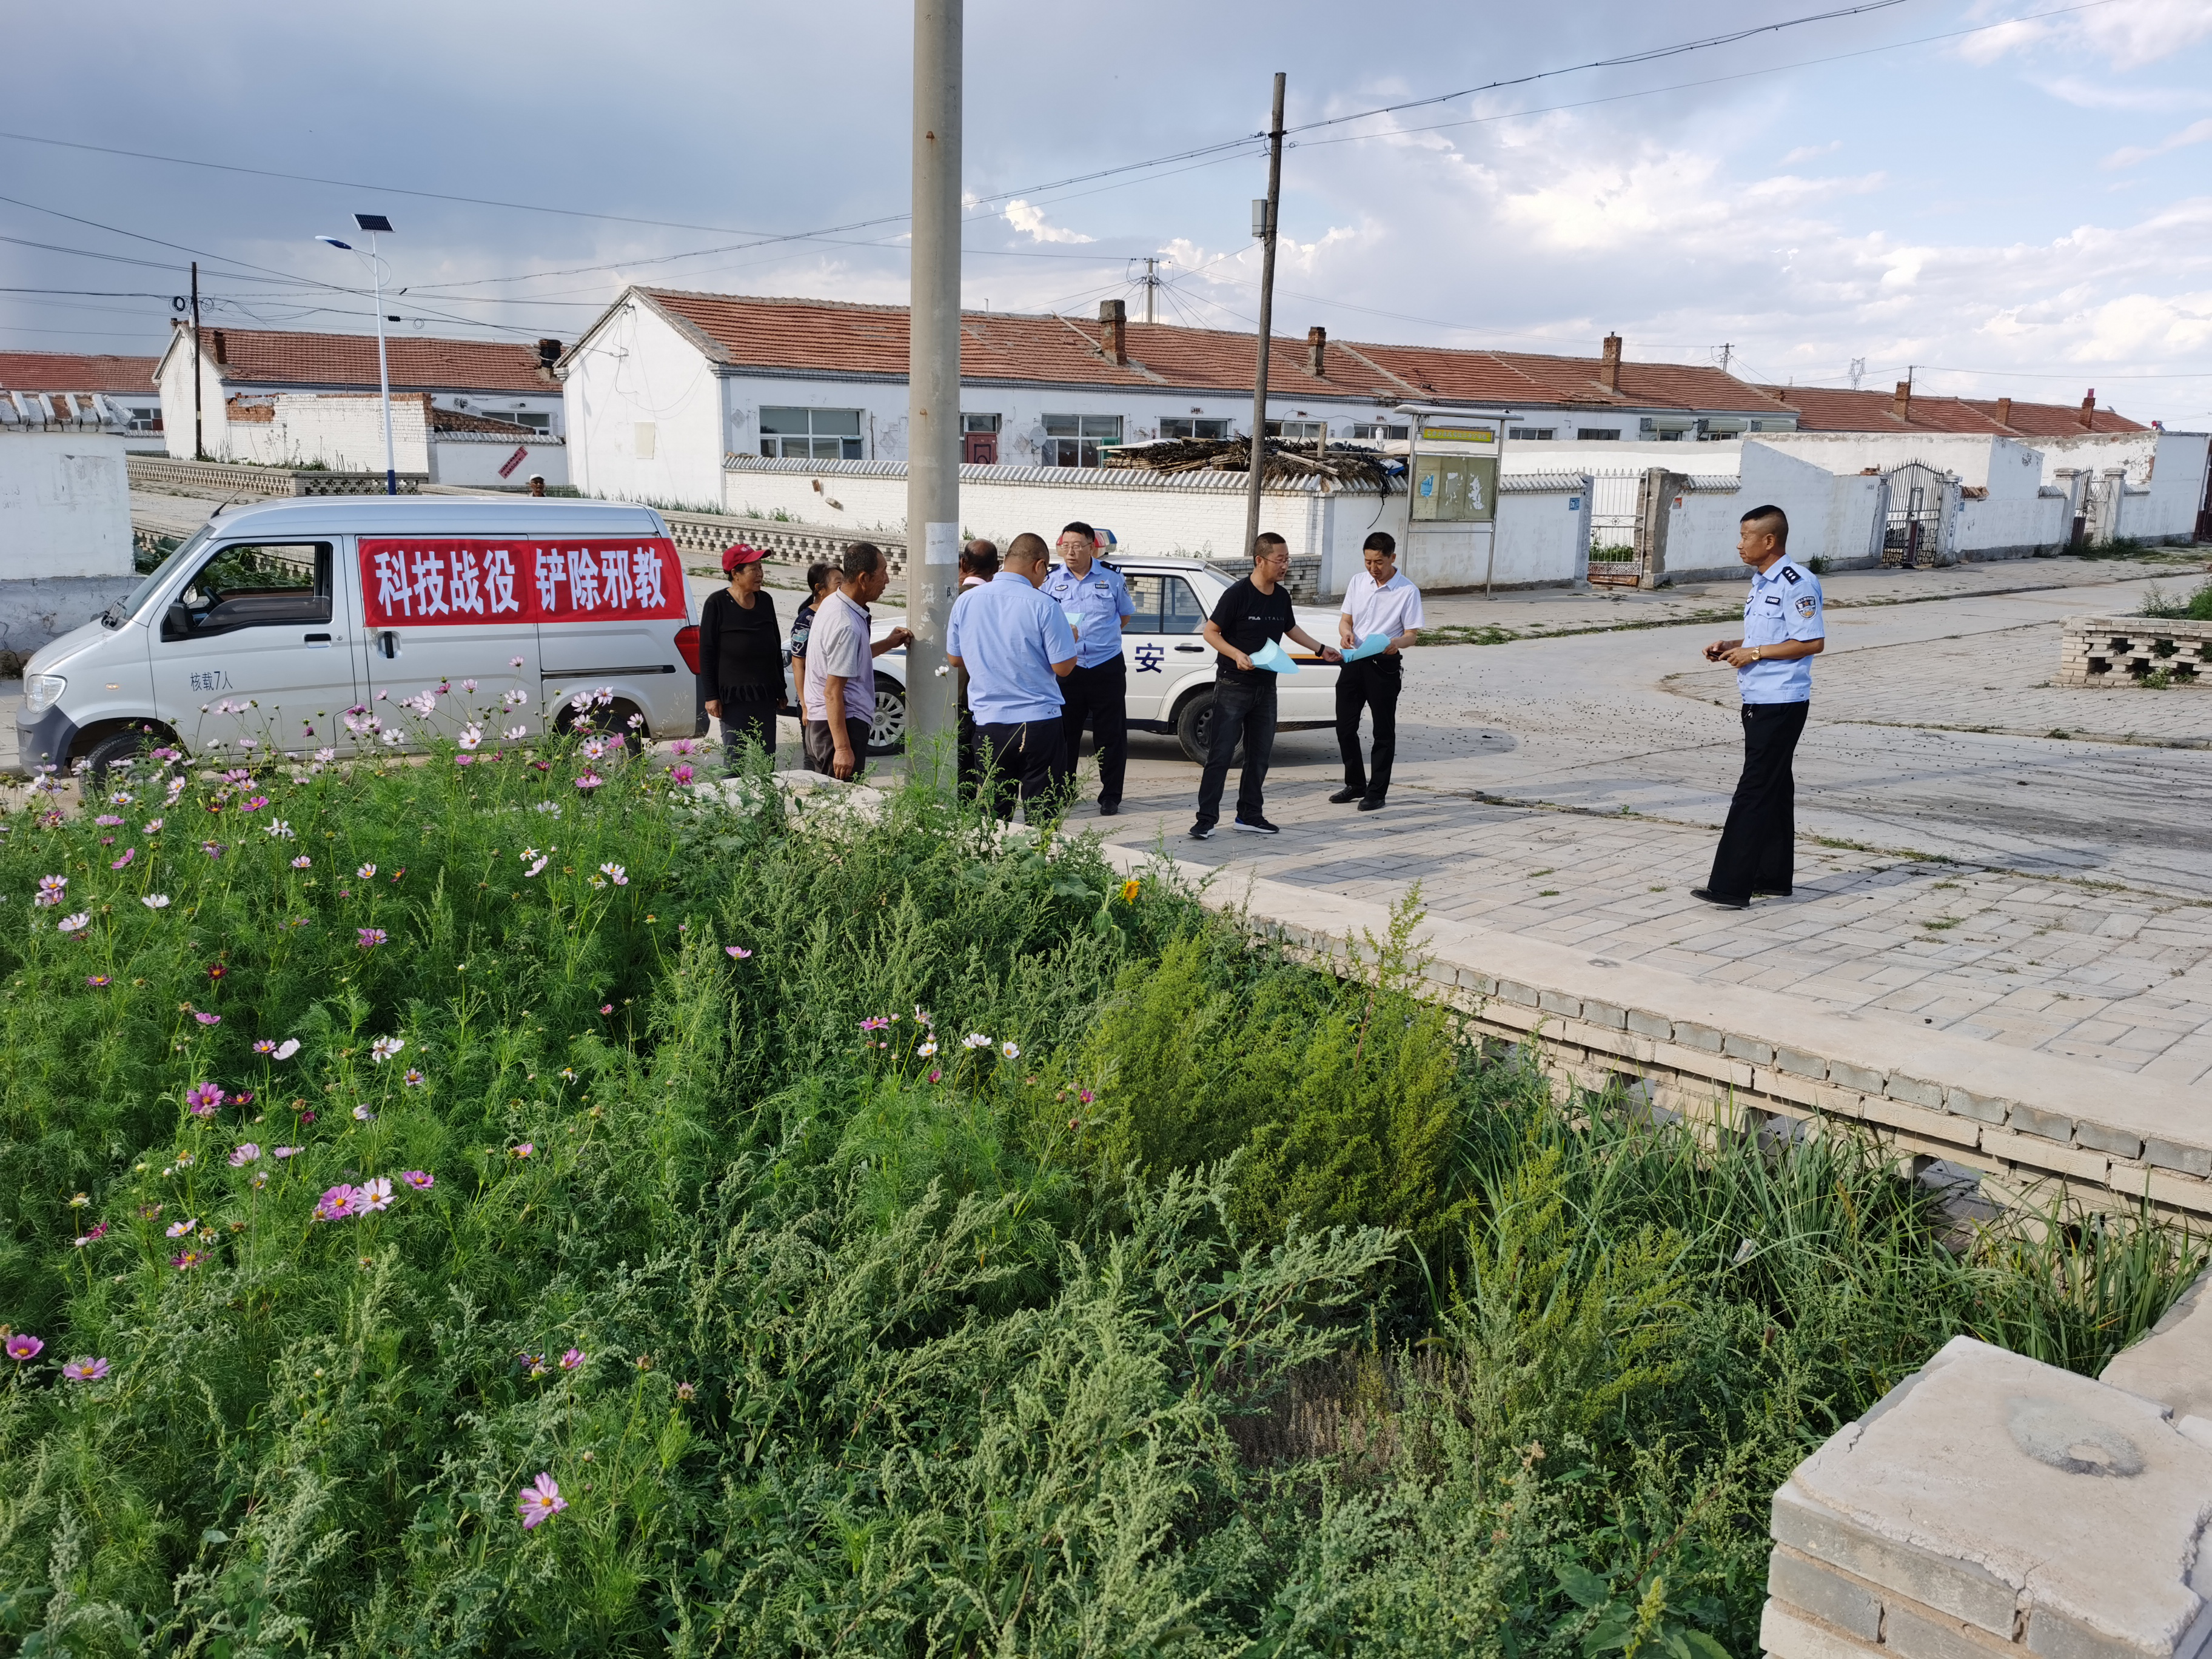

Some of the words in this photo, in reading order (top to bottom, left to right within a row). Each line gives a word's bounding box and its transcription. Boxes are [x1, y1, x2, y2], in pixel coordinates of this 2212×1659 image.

[374, 549, 519, 616] 科技战役
[535, 546, 666, 612] 铲除邪教
[1134, 643, 1164, 674] 安
[190, 671, 233, 692] 核载7人
